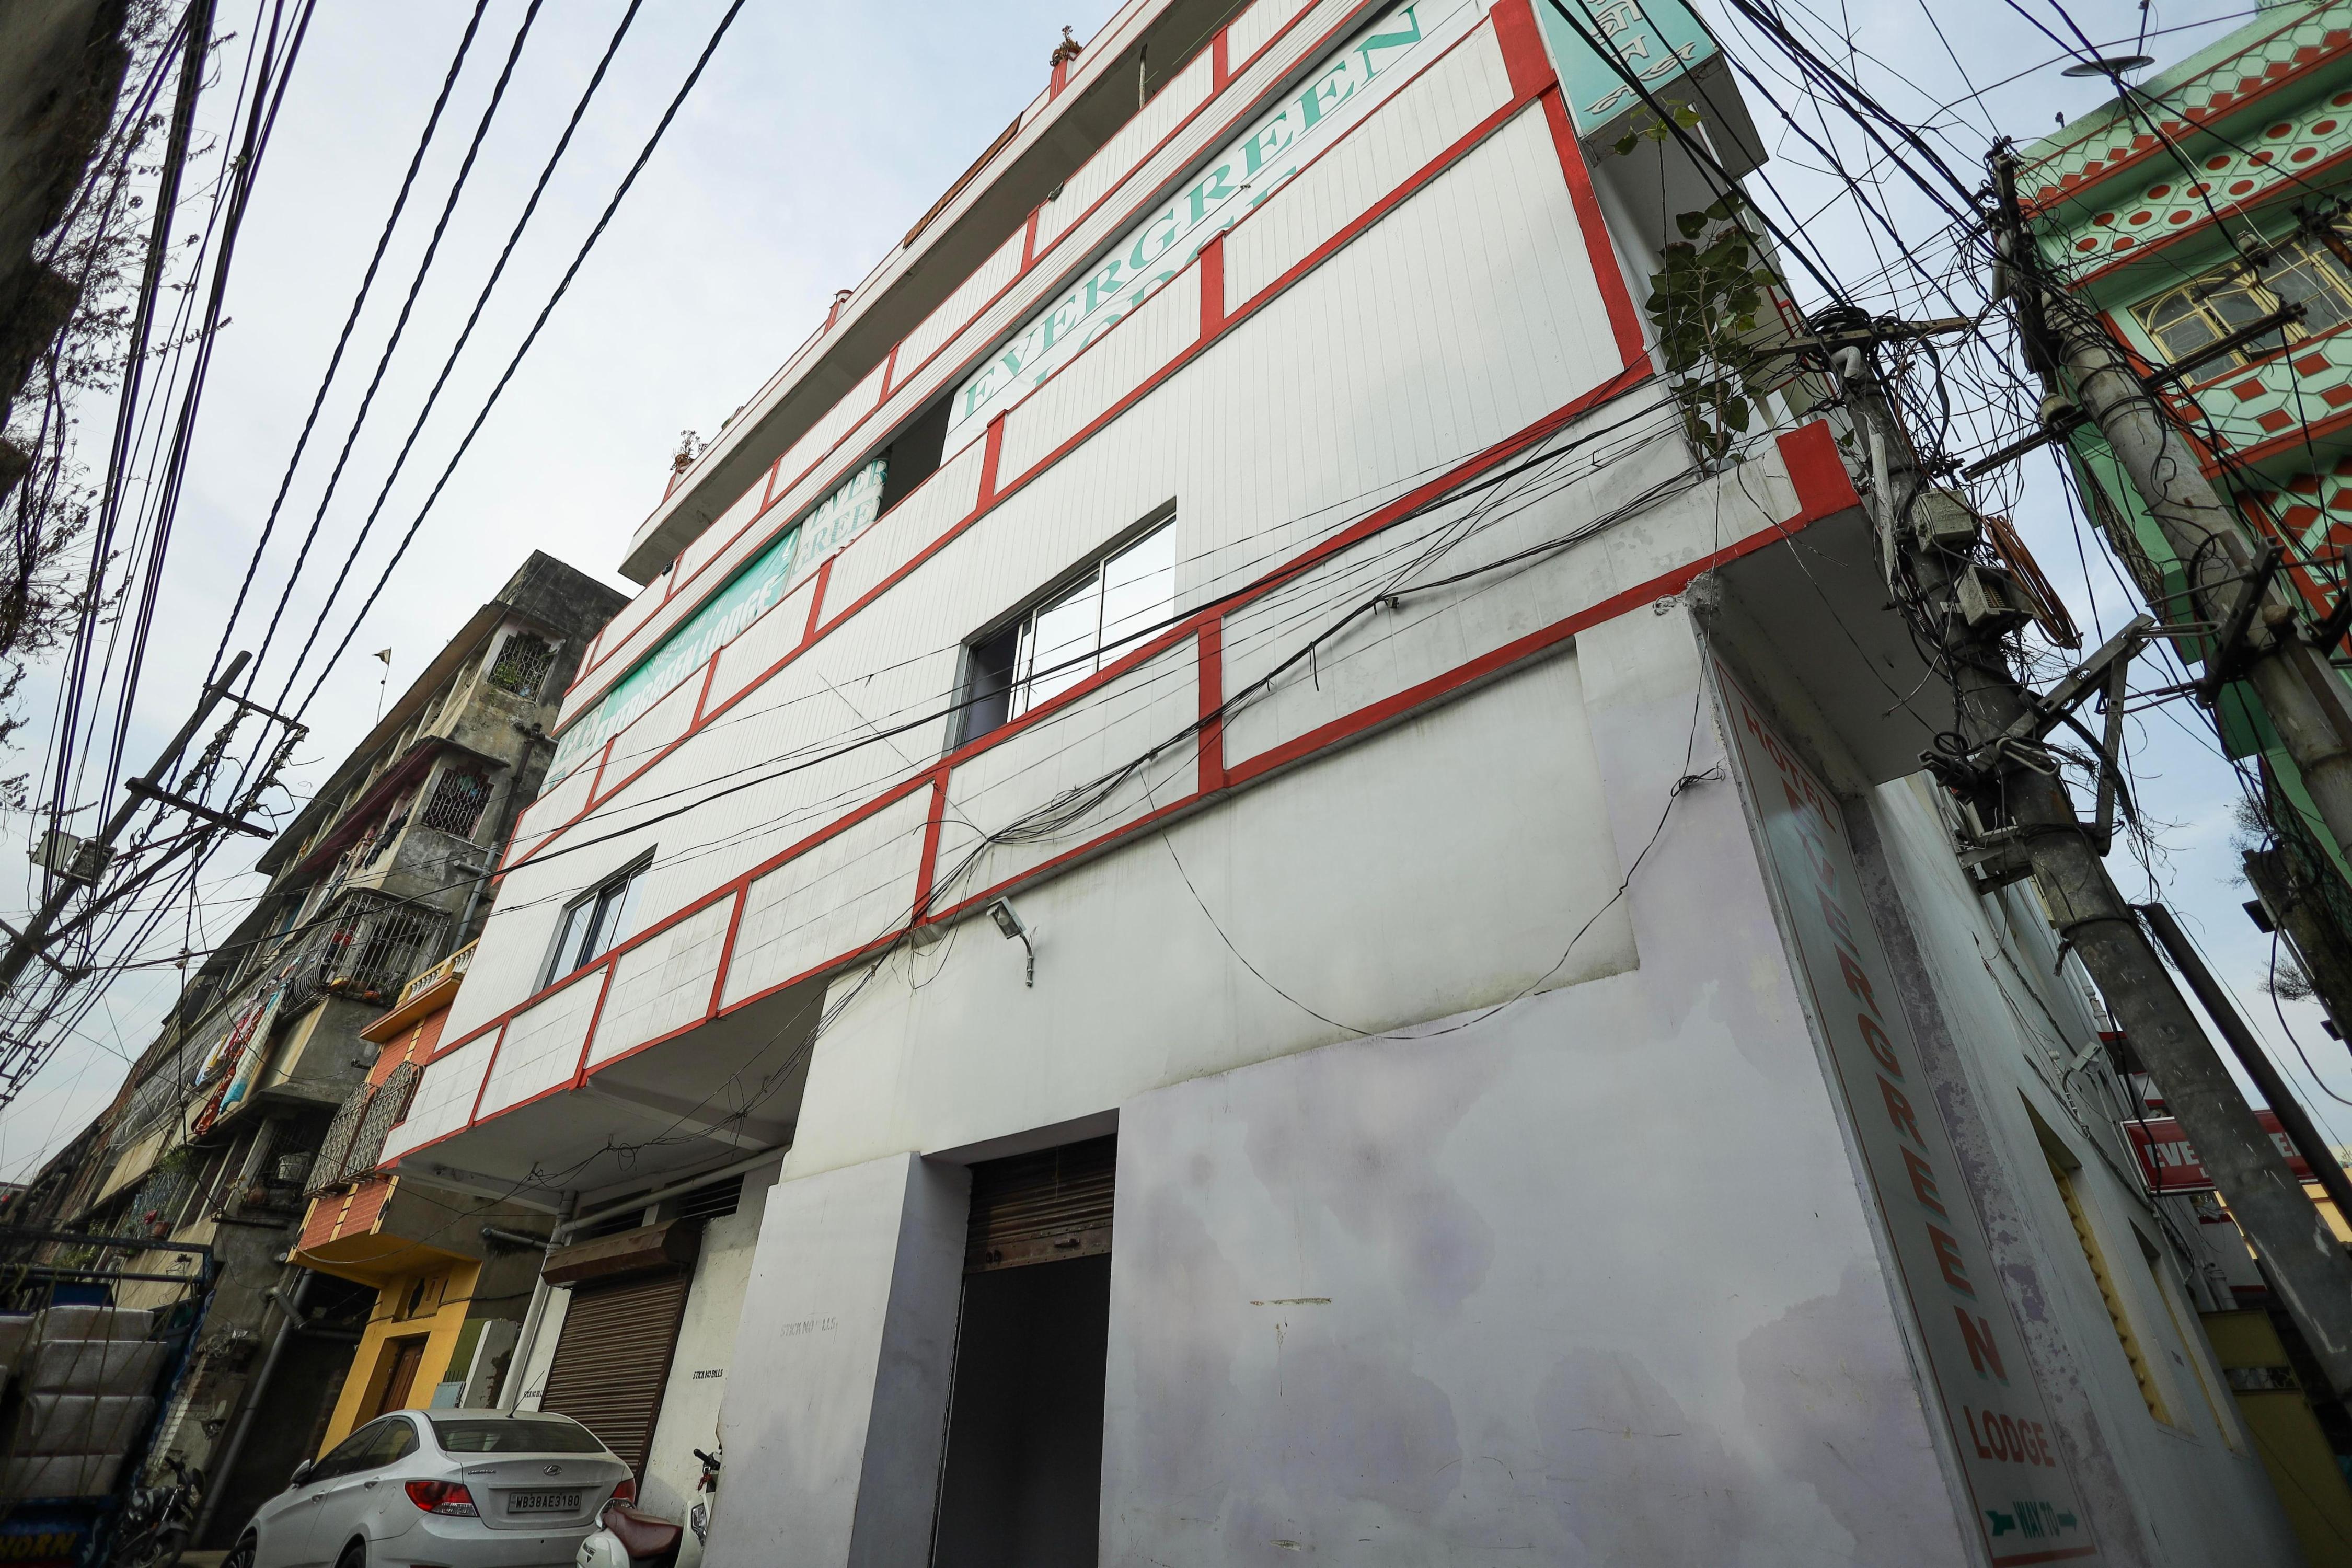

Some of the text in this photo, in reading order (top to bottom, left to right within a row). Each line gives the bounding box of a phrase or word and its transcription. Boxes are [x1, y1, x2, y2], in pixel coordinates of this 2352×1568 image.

[964, 0, 1421, 419] EVERGREEN
[697, 574, 778, 667] LODGE
[1740, 700, 1837, 835] HOTEL
[1780, 775, 2010, 1387] EVERGREEN
[1963, 1405, 2056, 1467] LODGE
[516, 1495, 580, 1508] WB38AE3180
[2013, 1501, 2061, 1539] WAY TO
